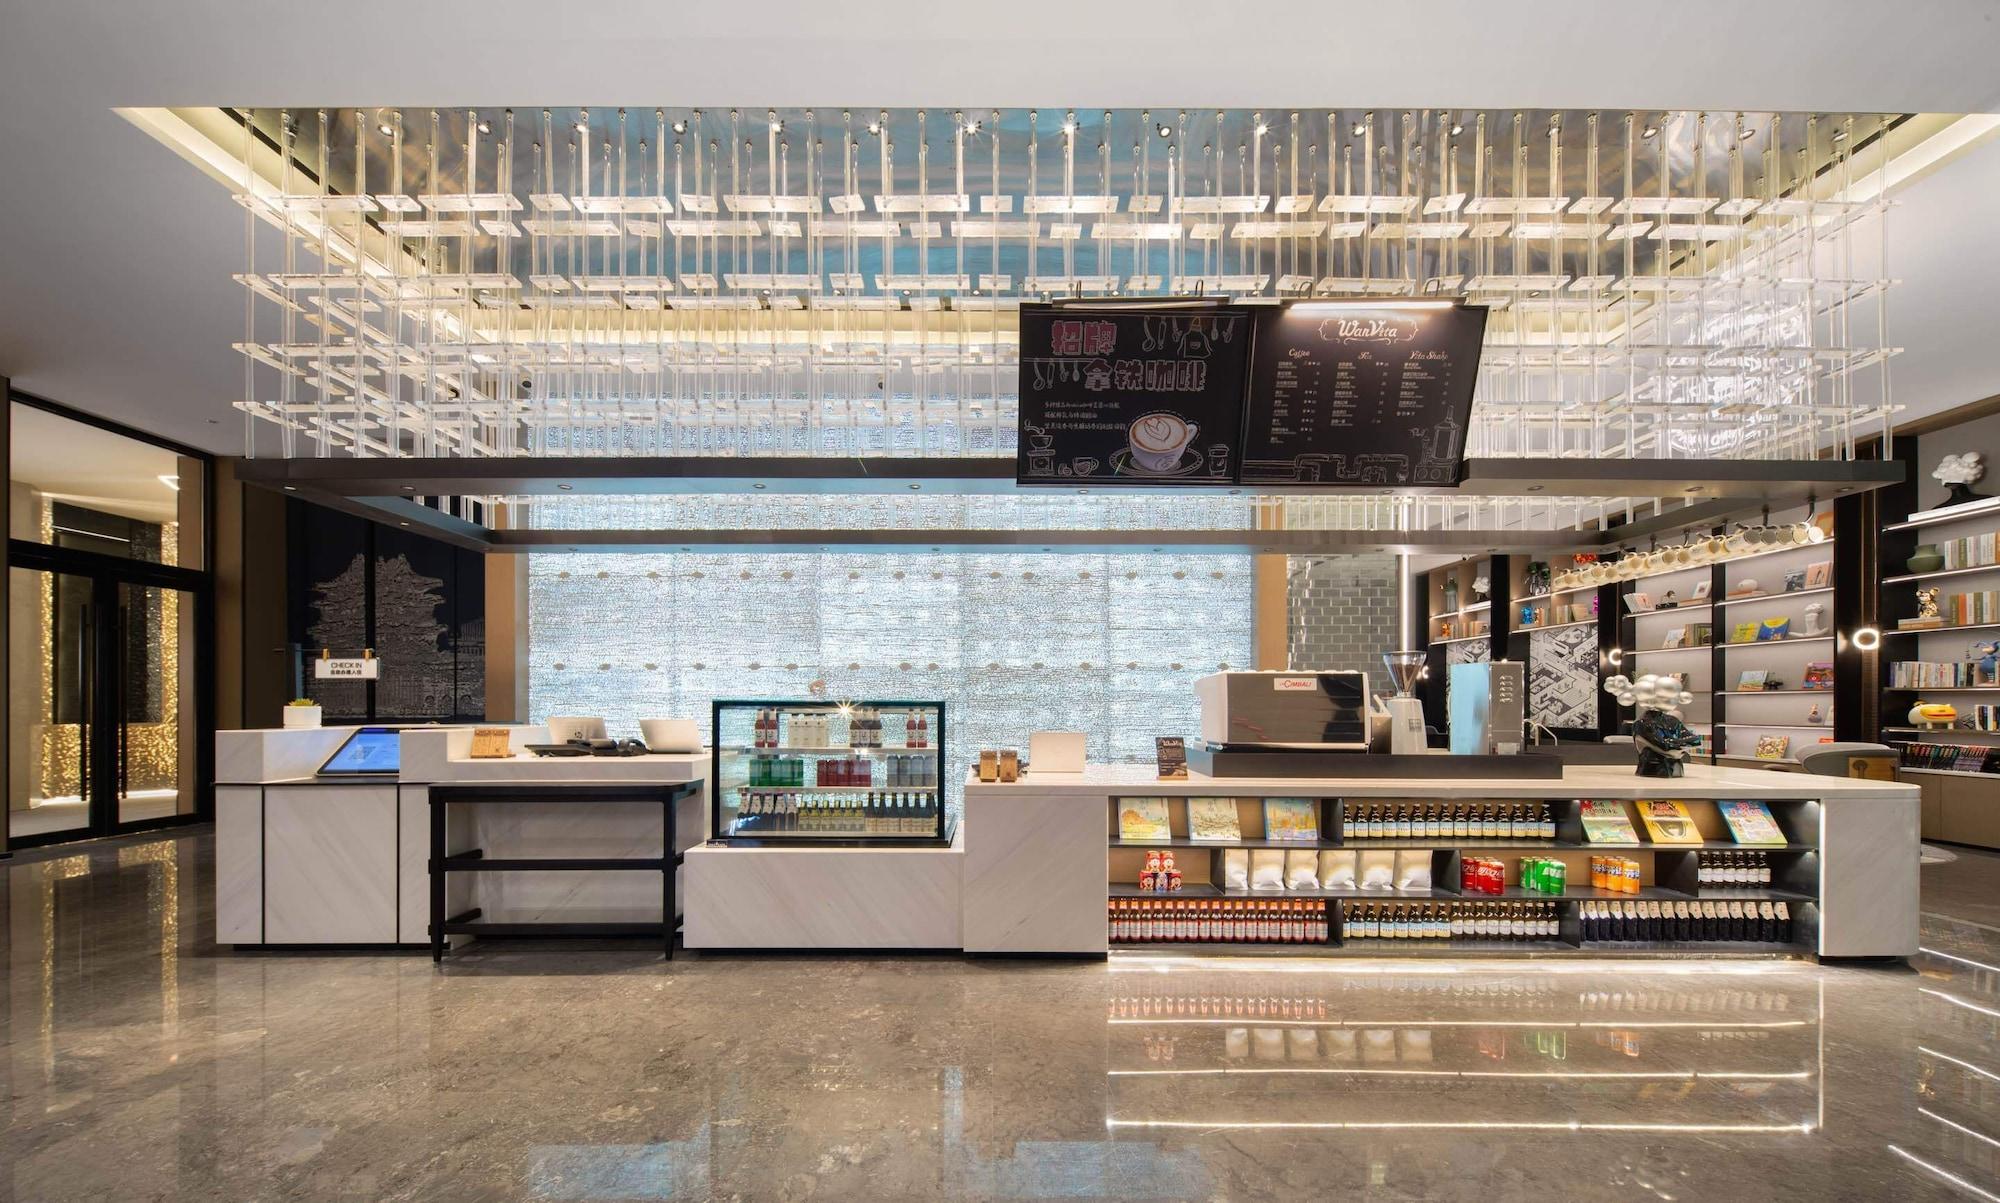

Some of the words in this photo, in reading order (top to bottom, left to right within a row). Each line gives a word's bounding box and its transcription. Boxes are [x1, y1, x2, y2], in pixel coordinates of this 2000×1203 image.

[1051, 319, 1118, 356] 招牌
[1338, 319, 1399, 338] WanVita
[1288, 348, 1311, 359] Coffee
[1083, 358, 1207, 392] 拿铁咖啡
